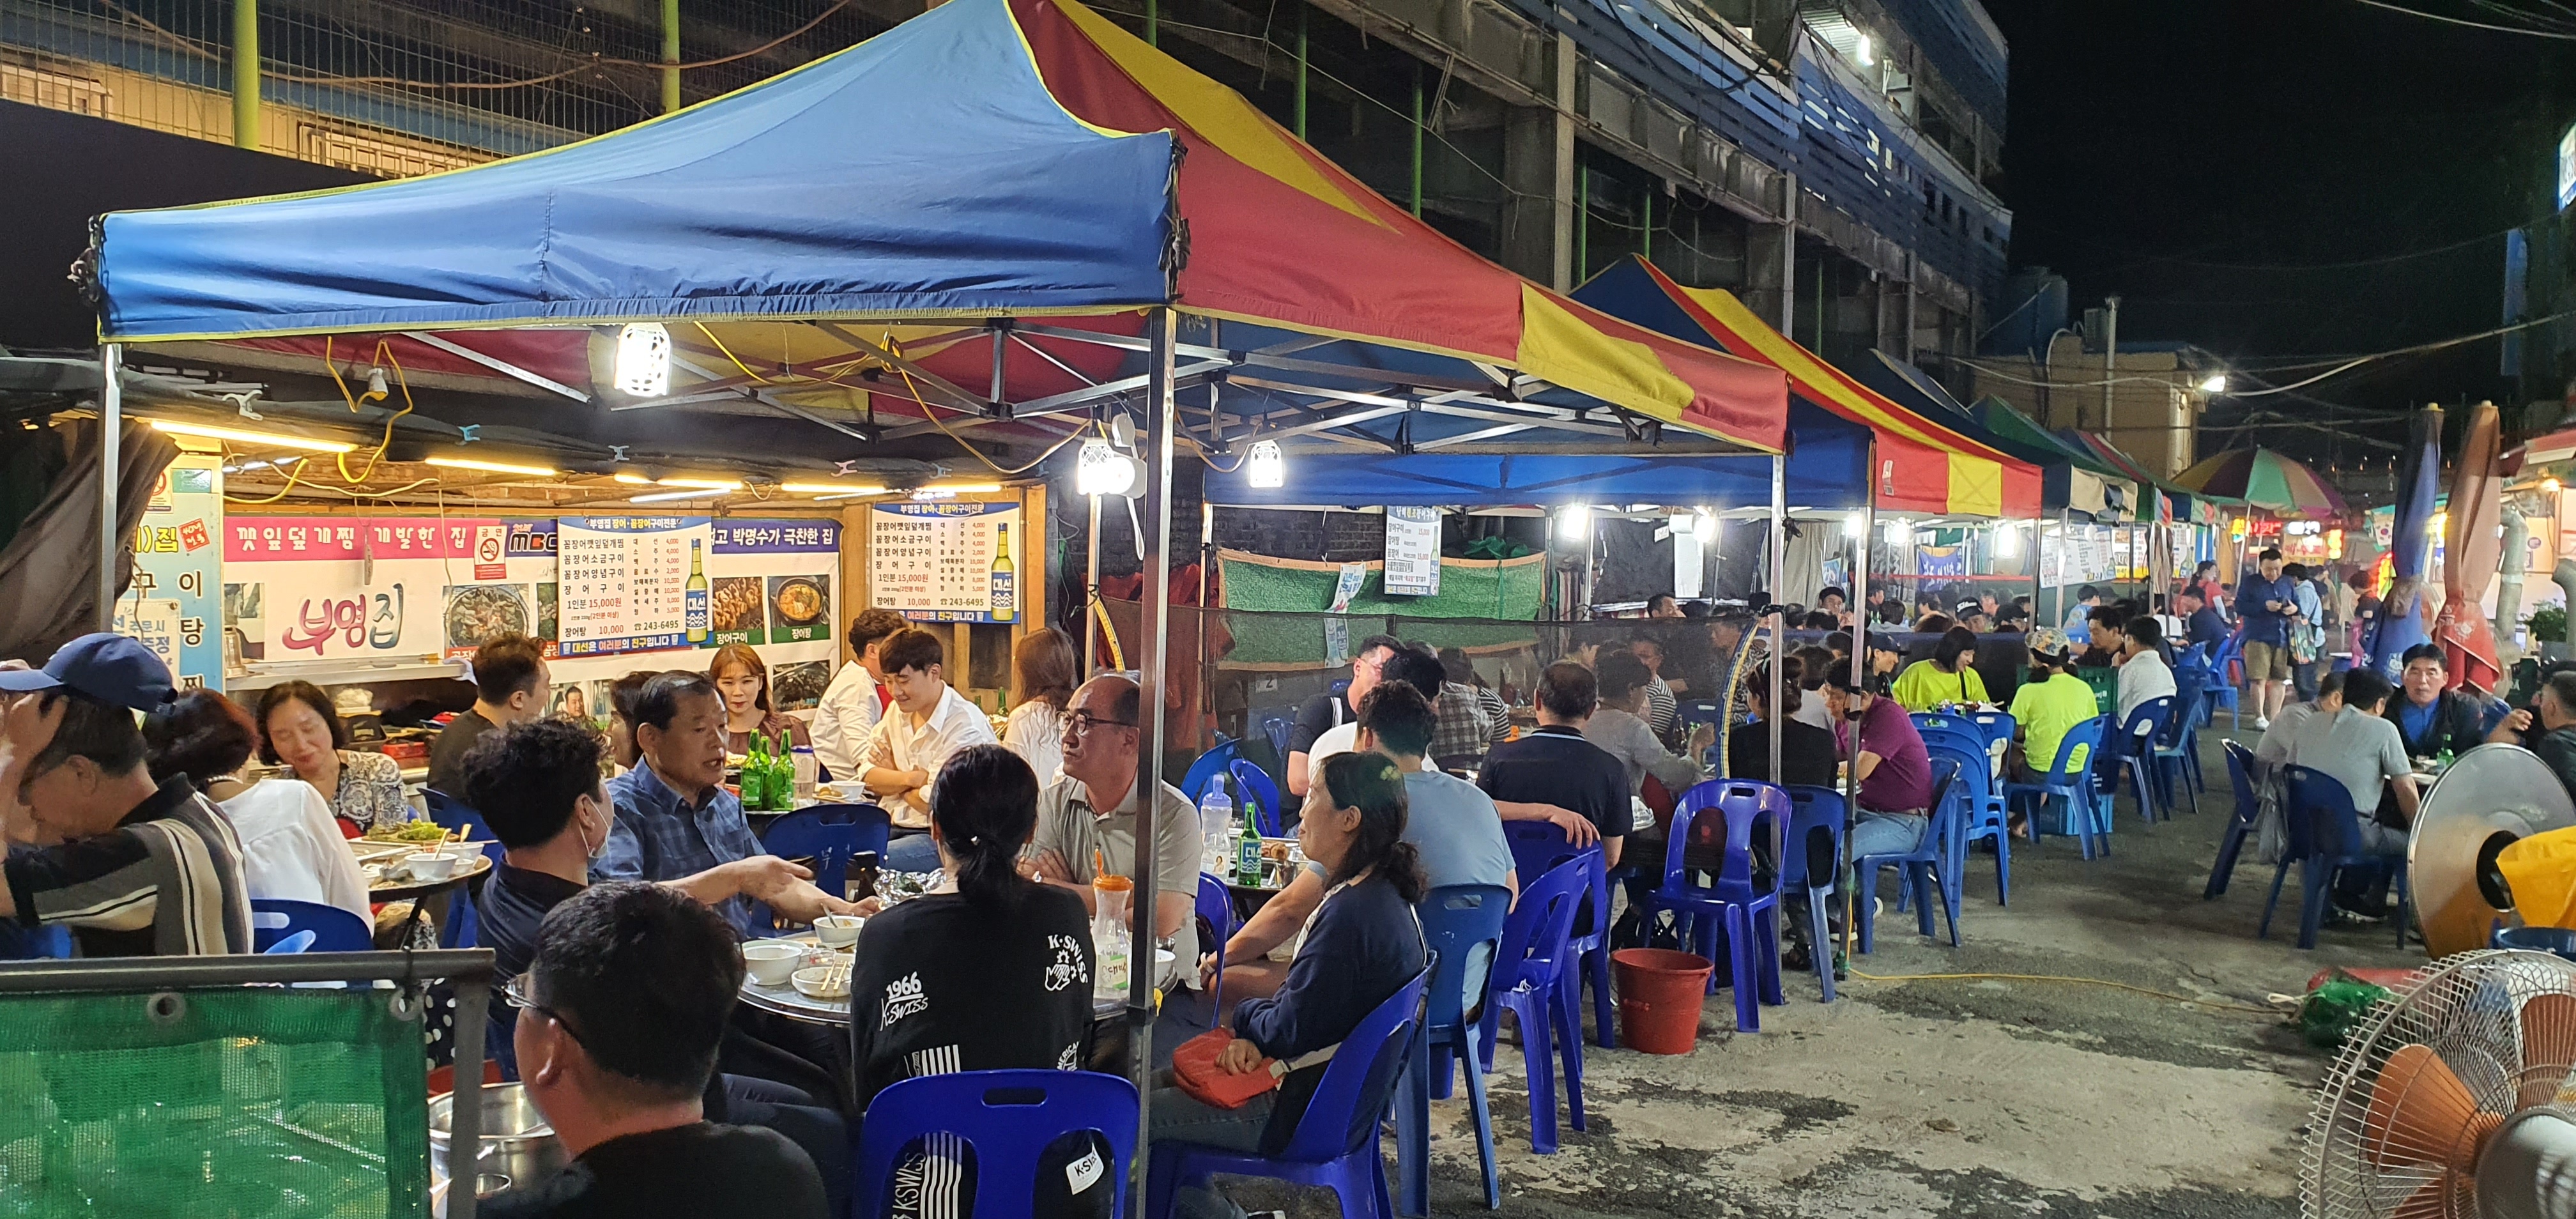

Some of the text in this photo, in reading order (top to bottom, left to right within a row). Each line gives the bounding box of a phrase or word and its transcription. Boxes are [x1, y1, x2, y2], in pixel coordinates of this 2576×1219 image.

[900, 505, 920, 514] 부영집
[590, 518, 611, 529] 부영집
[374, 526, 436, 550] 개발한
[450, 526, 466, 549] 집
[733, 527, 781, 546] 박명수가
[783, 527, 818, 546] 극찬한
[822, 528, 834, 545] 집
[876, 535, 931, 544] 꼼장어소금구이
[564, 553, 624, 565] 꼼장어소금구이
[564, 567, 624, 579] 꼼장어양념구이
[878, 574, 896, 582] 1인분
[993, 578, 1012, 592] 대선
[567, 599, 586, 610] 1인분
[687, 597, 706, 611] 대선
[877, 597, 931, 606] 장어탕 10,000
[949, 598, 984, 606] 243-6495
[282, 582, 404, 656] 부영집
[937, 611, 974, 622] 친구입니다
[180, 617, 204, 645] 탕
[565, 624, 624, 638] 장어탕 10,000
[643, 620, 679, 631] 243-6495
[716, 631, 747, 645] 장어구이
[792, 627, 811, 640] 장어탕
[631, 634, 670, 649] 친구입니다
[1266, 675, 1273, 688] 2
[886, 971, 922, 997] 1966
